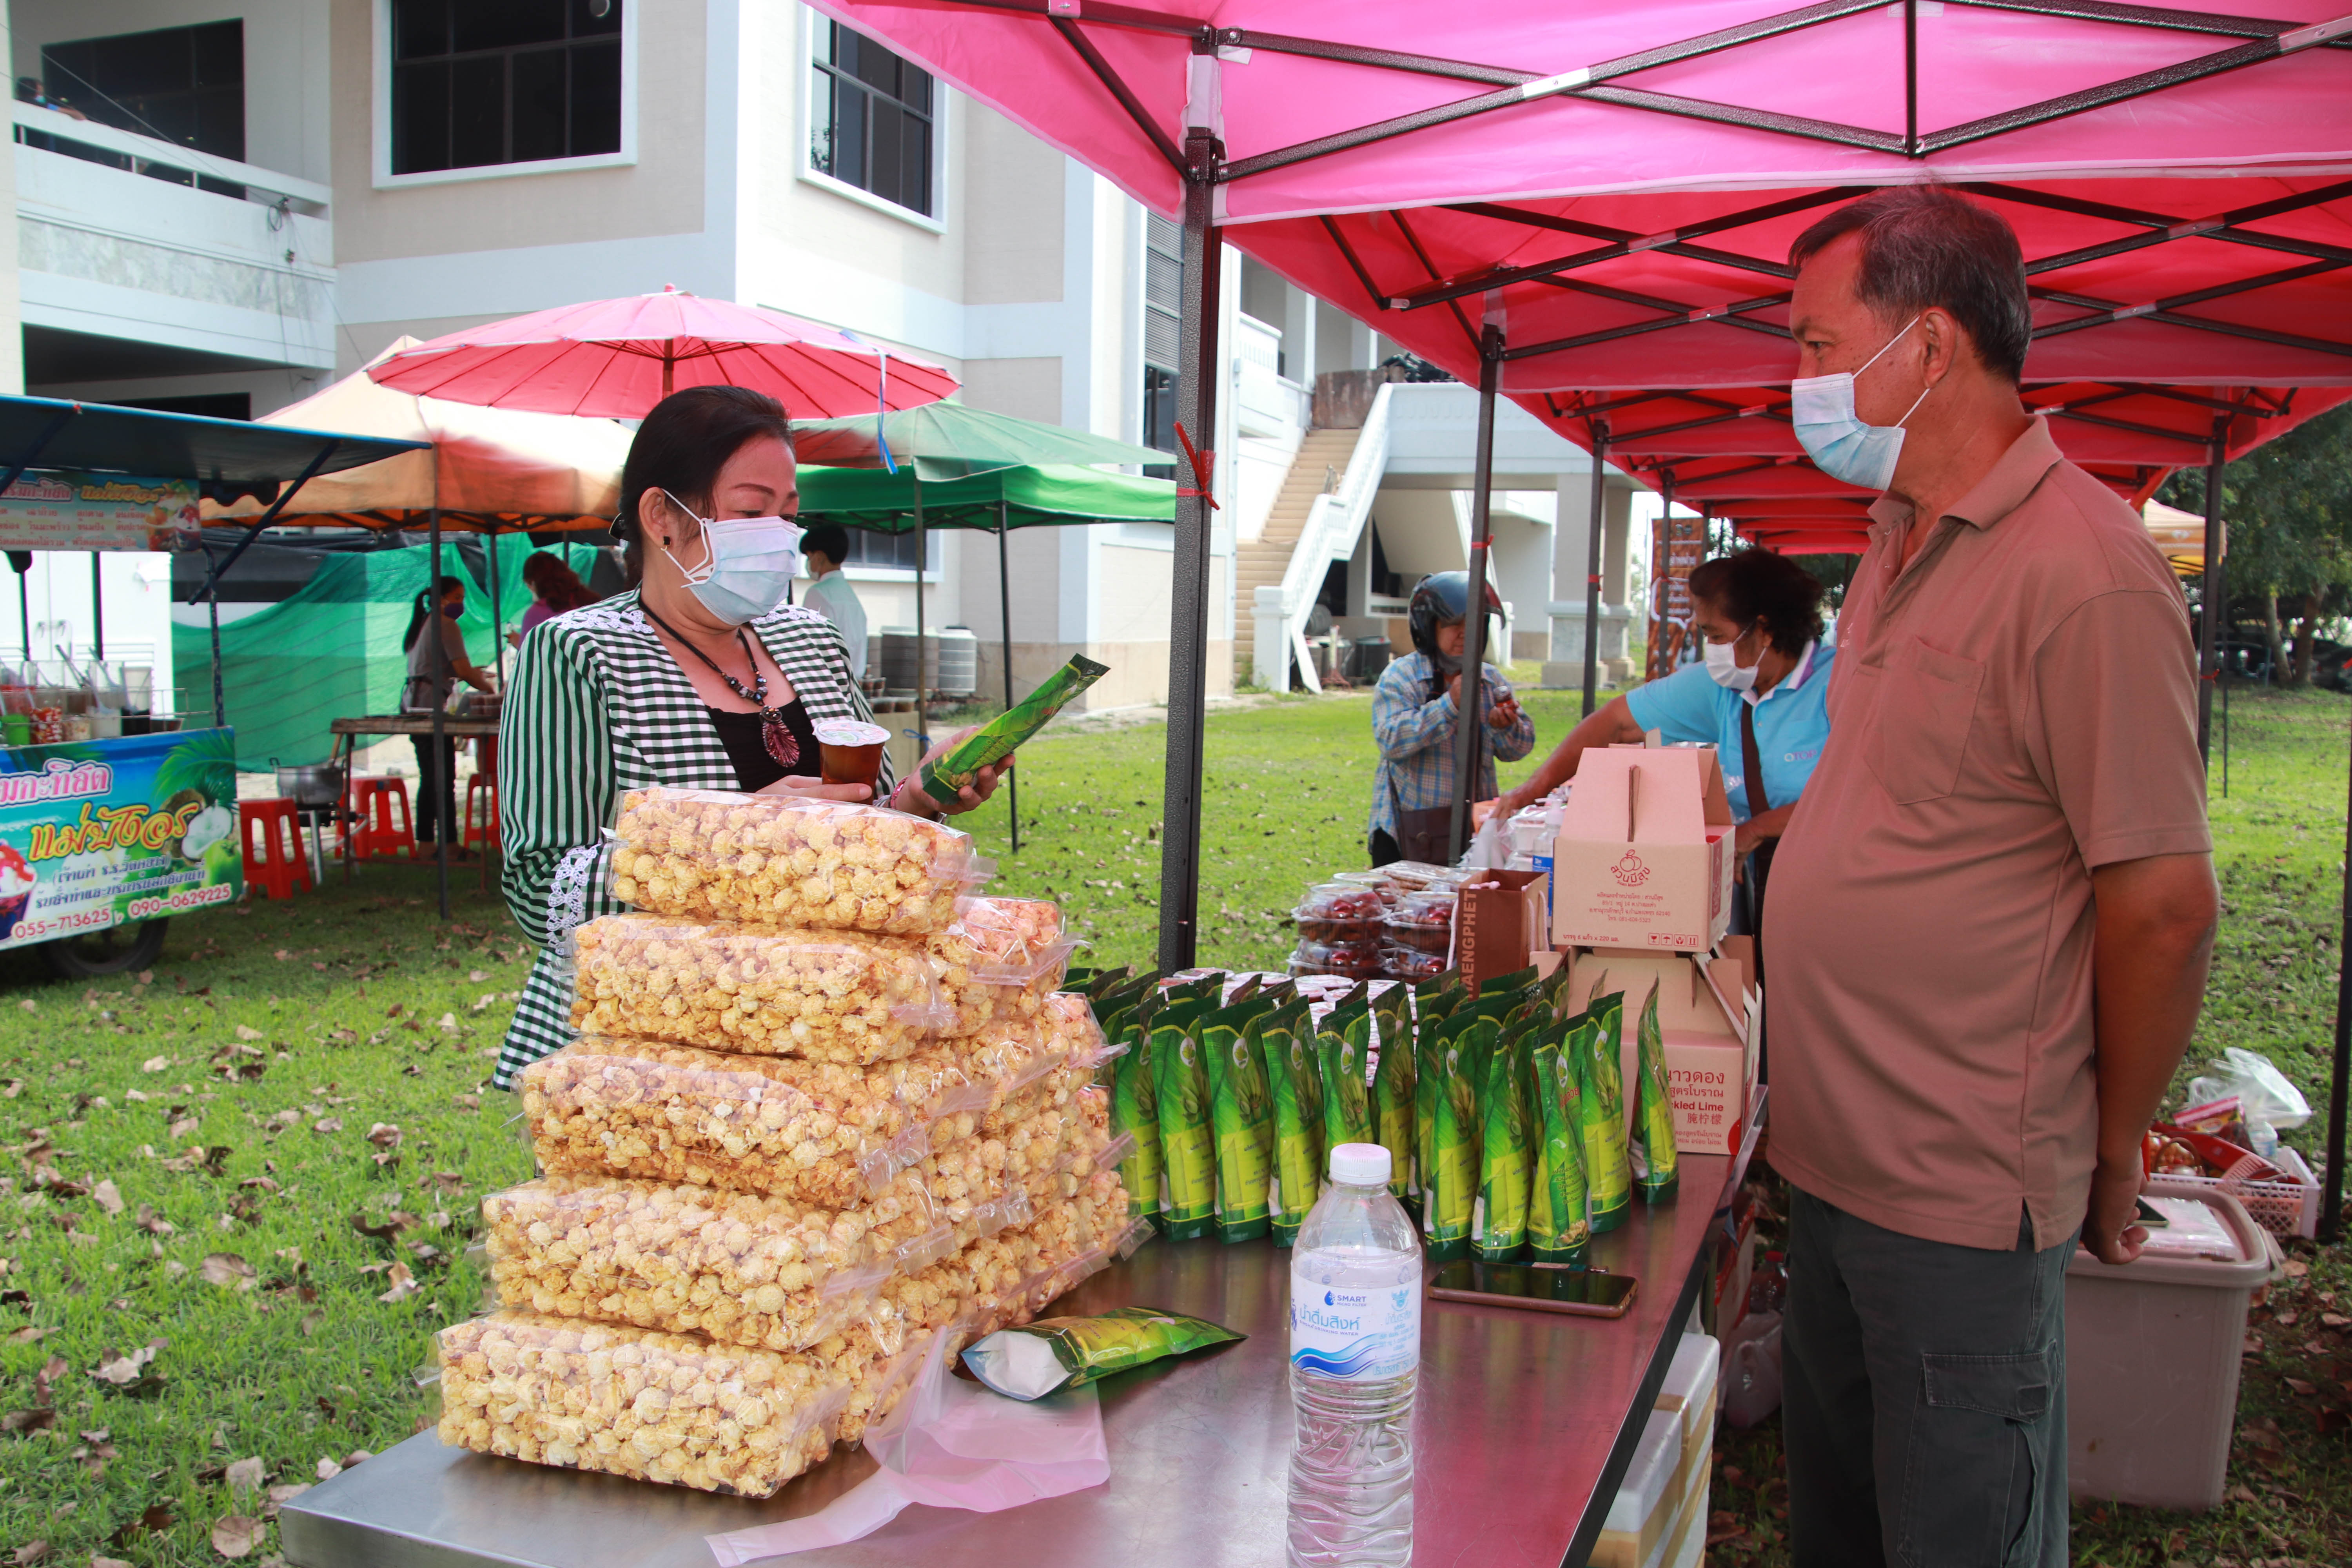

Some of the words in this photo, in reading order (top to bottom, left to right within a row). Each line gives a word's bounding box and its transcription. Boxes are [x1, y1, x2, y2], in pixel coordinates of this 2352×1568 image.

[1784, 749, 1817, 762] OTOP
[29, 802, 199, 862] แม่บังอร
[1610, 865, 1650, 883] สวนมีสุข
[15, 908, 110, 938] 055-713625
[131, 885, 231, 916] 090-0629225
[1672, 1100, 1695, 1110] kled
[1699, 1102, 1724, 1111] Lime
[1300, 1303, 1361, 1330] น้ำดื่มสิงห์
[1314, 1326, 1338, 1334] DRINKING
